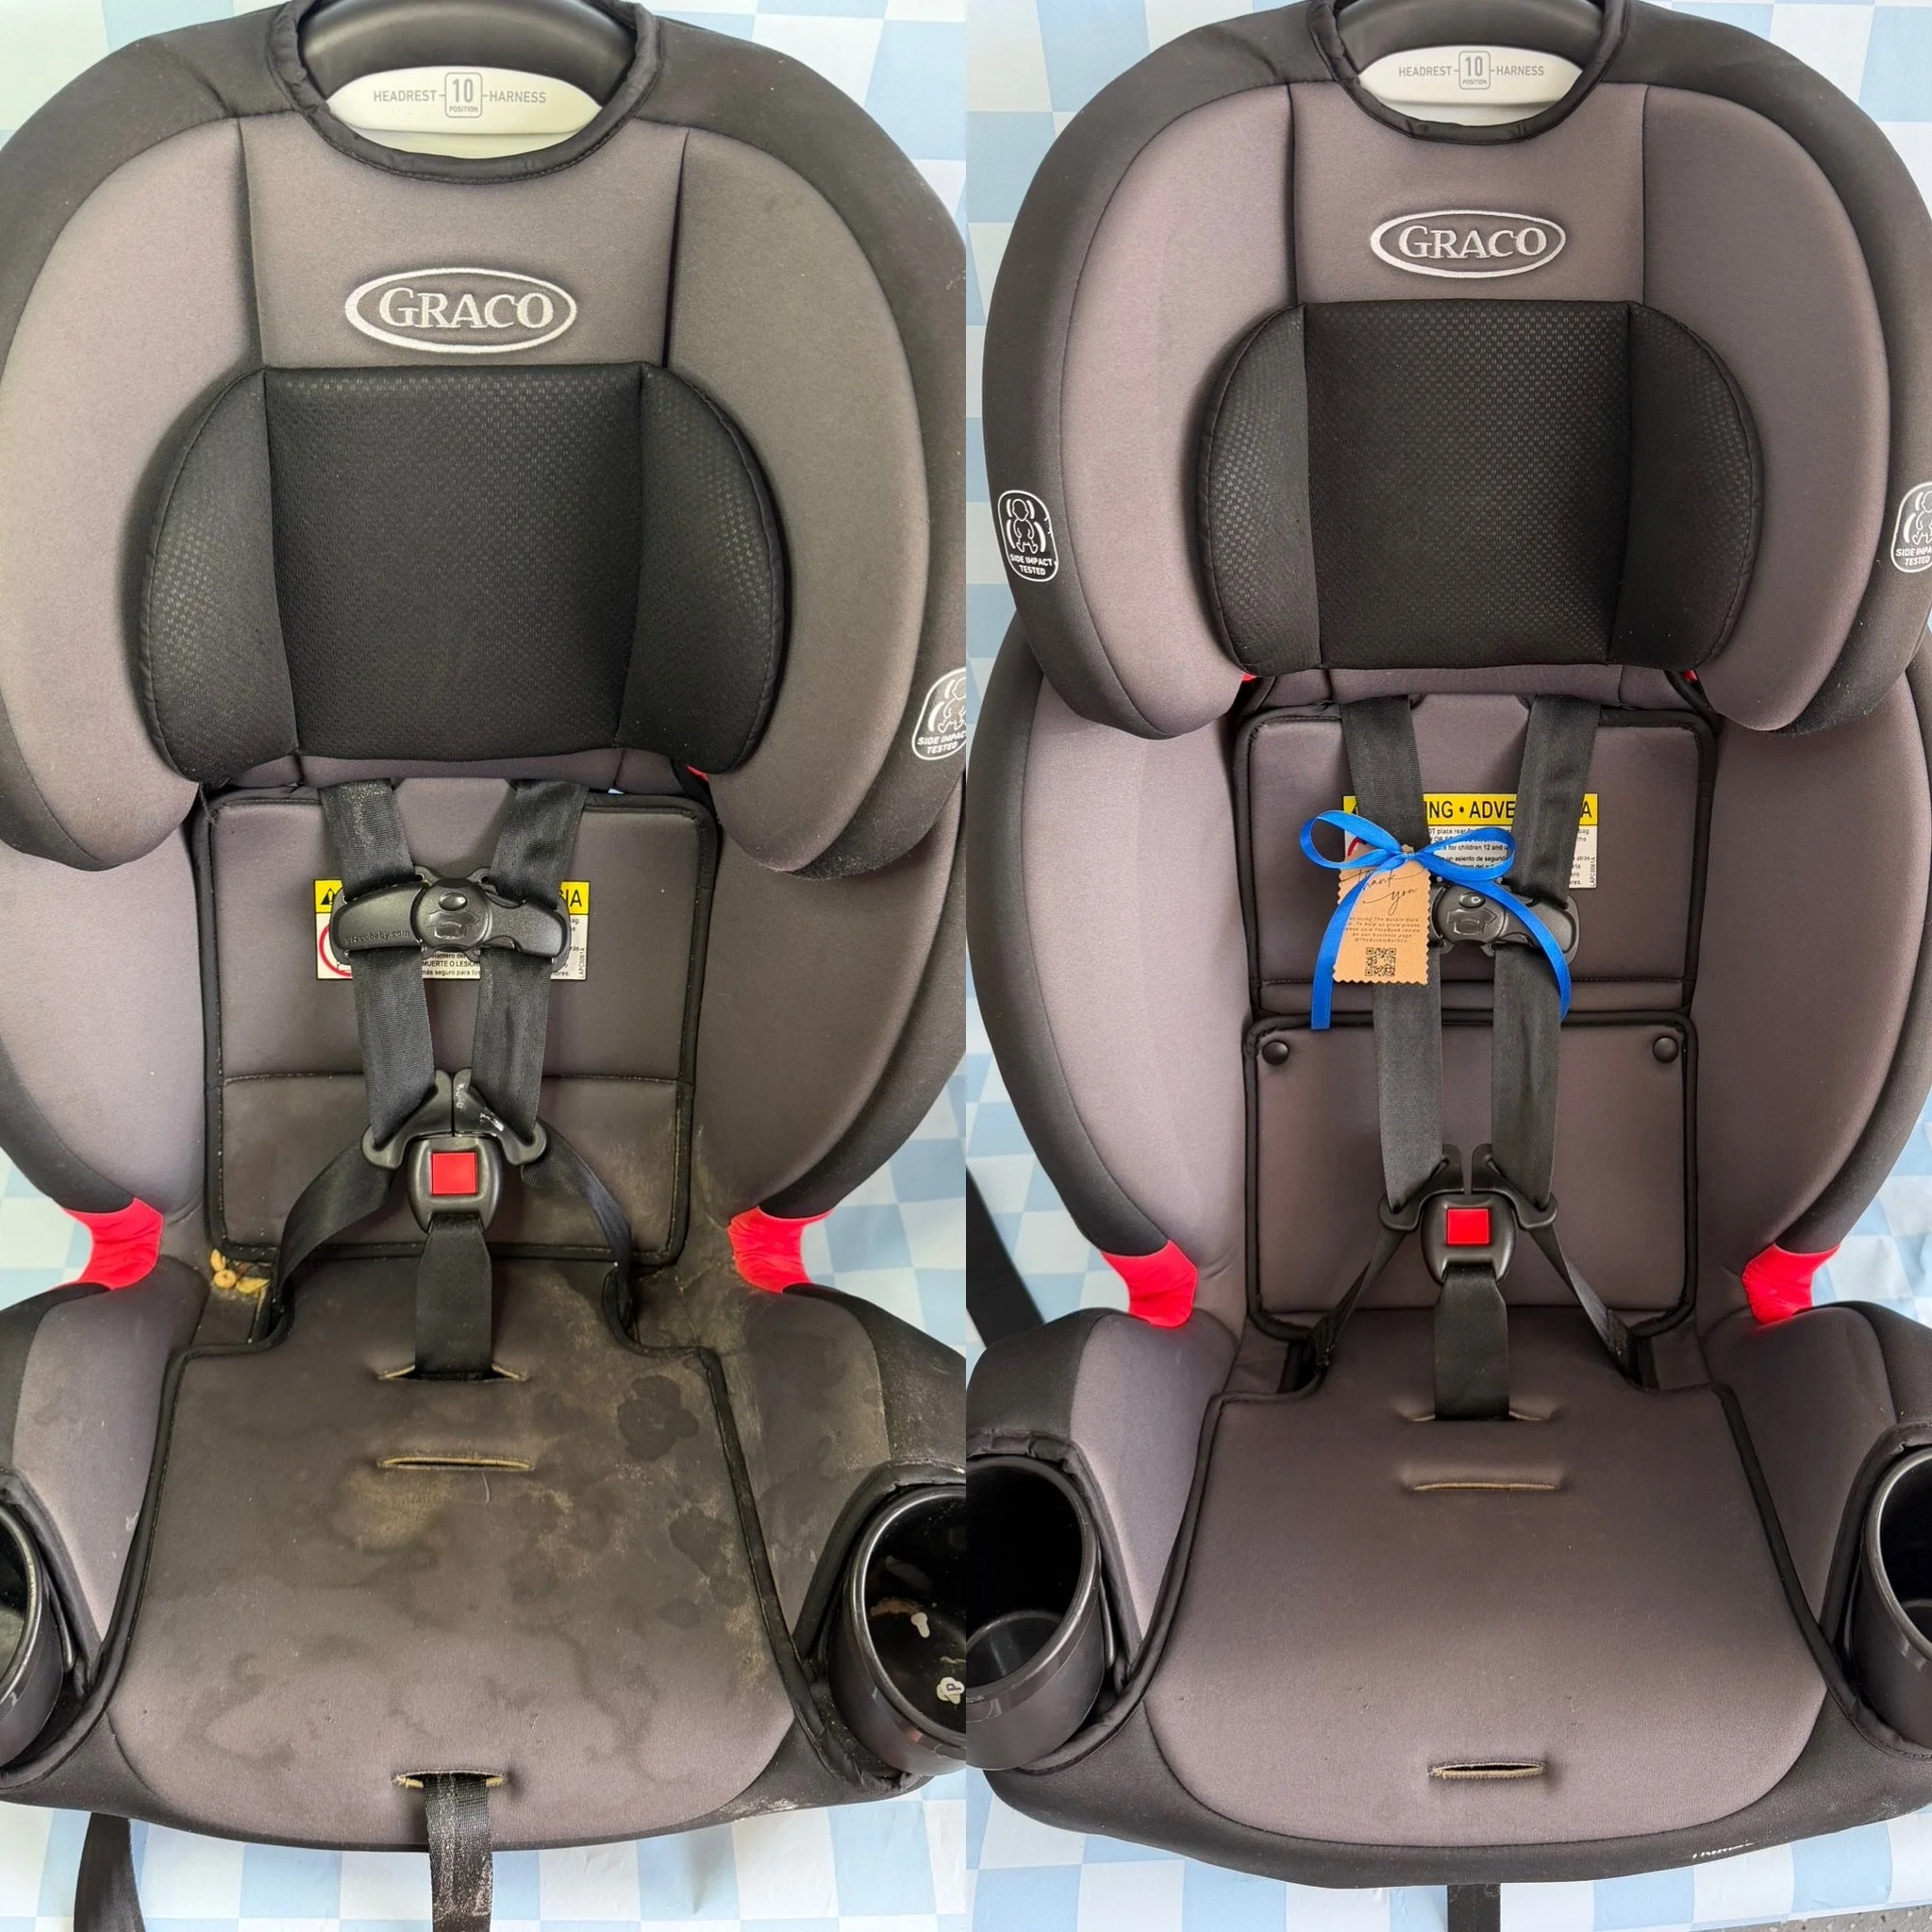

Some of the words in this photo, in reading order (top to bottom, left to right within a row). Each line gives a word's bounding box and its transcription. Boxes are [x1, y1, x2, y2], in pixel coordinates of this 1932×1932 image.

[1399, 66, 1452, 76] HEADREST
[1465, 56, 1483, 76] 10
[1496, 66, 1544, 76] HARNESS
[374, 90, 437, 103] HEADREST
[453, 78, 474, 103] 10
[490, 91, 546, 104] HARNESS
[1398, 225, 1547, 259] GRACO
[378, 287, 554, 328] GRACO
[1895, 548, 1916, 557] SIDE
[1916, 546, 1932, 556] IMPA
[1009, 554, 1024, 564] SIDE
[1024, 556, 1053, 566] IMPACT
[1905, 556, 1931, 566] TESTED
[1019, 564, 1046, 575] TESTED
[917, 736, 941, 745] SIDE
[941, 730, 966, 743] IMPAC
[926, 741, 958, 755] TESTED
